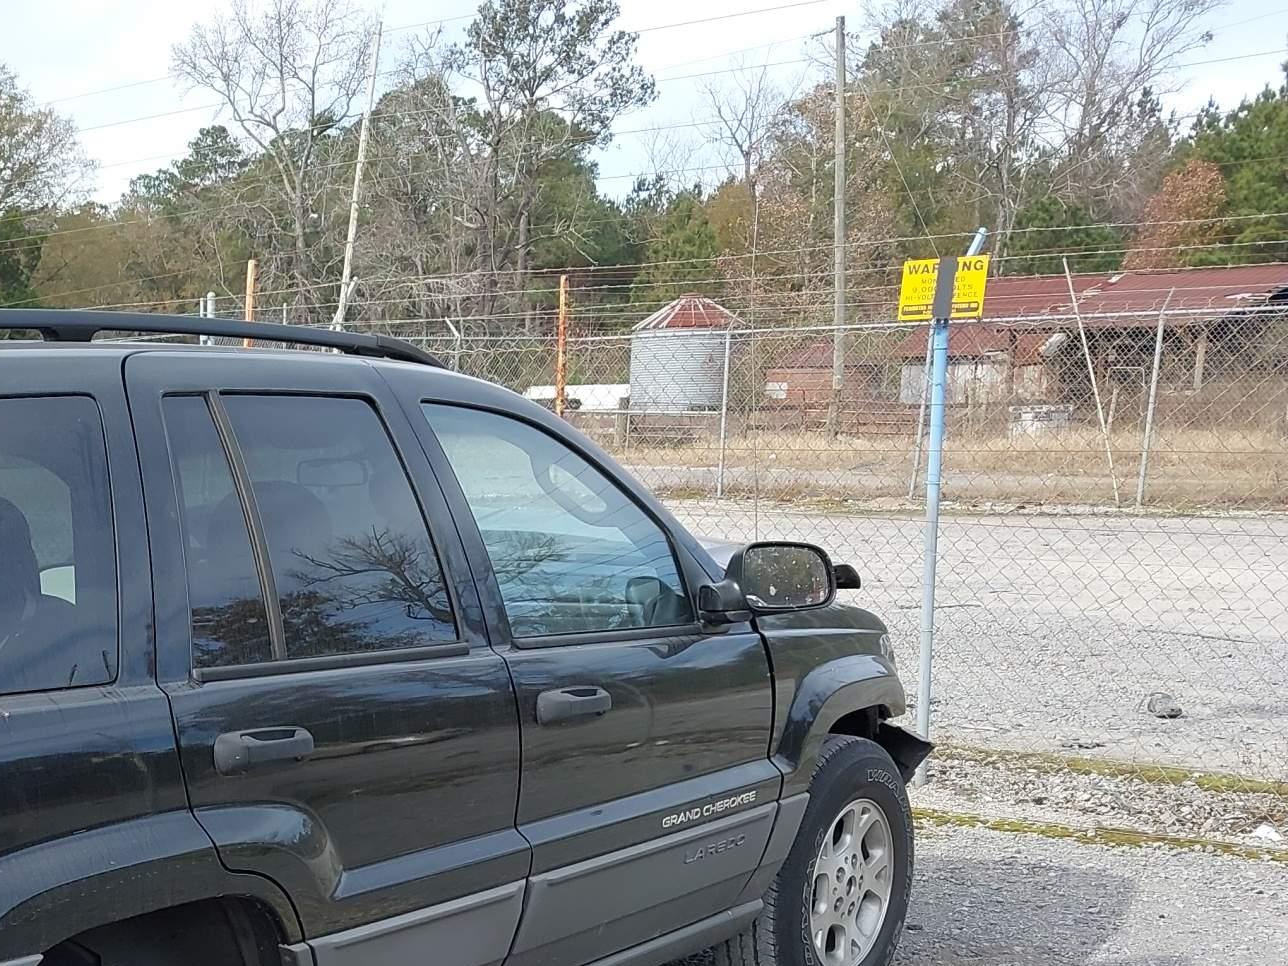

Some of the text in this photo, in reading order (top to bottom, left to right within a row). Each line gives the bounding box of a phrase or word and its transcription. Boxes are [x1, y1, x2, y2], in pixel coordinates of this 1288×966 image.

[908, 260, 984, 275] WARNG
[662, 790, 757, 828] GRAND CHEROKEE
[684, 833, 746, 864] LAREDO
